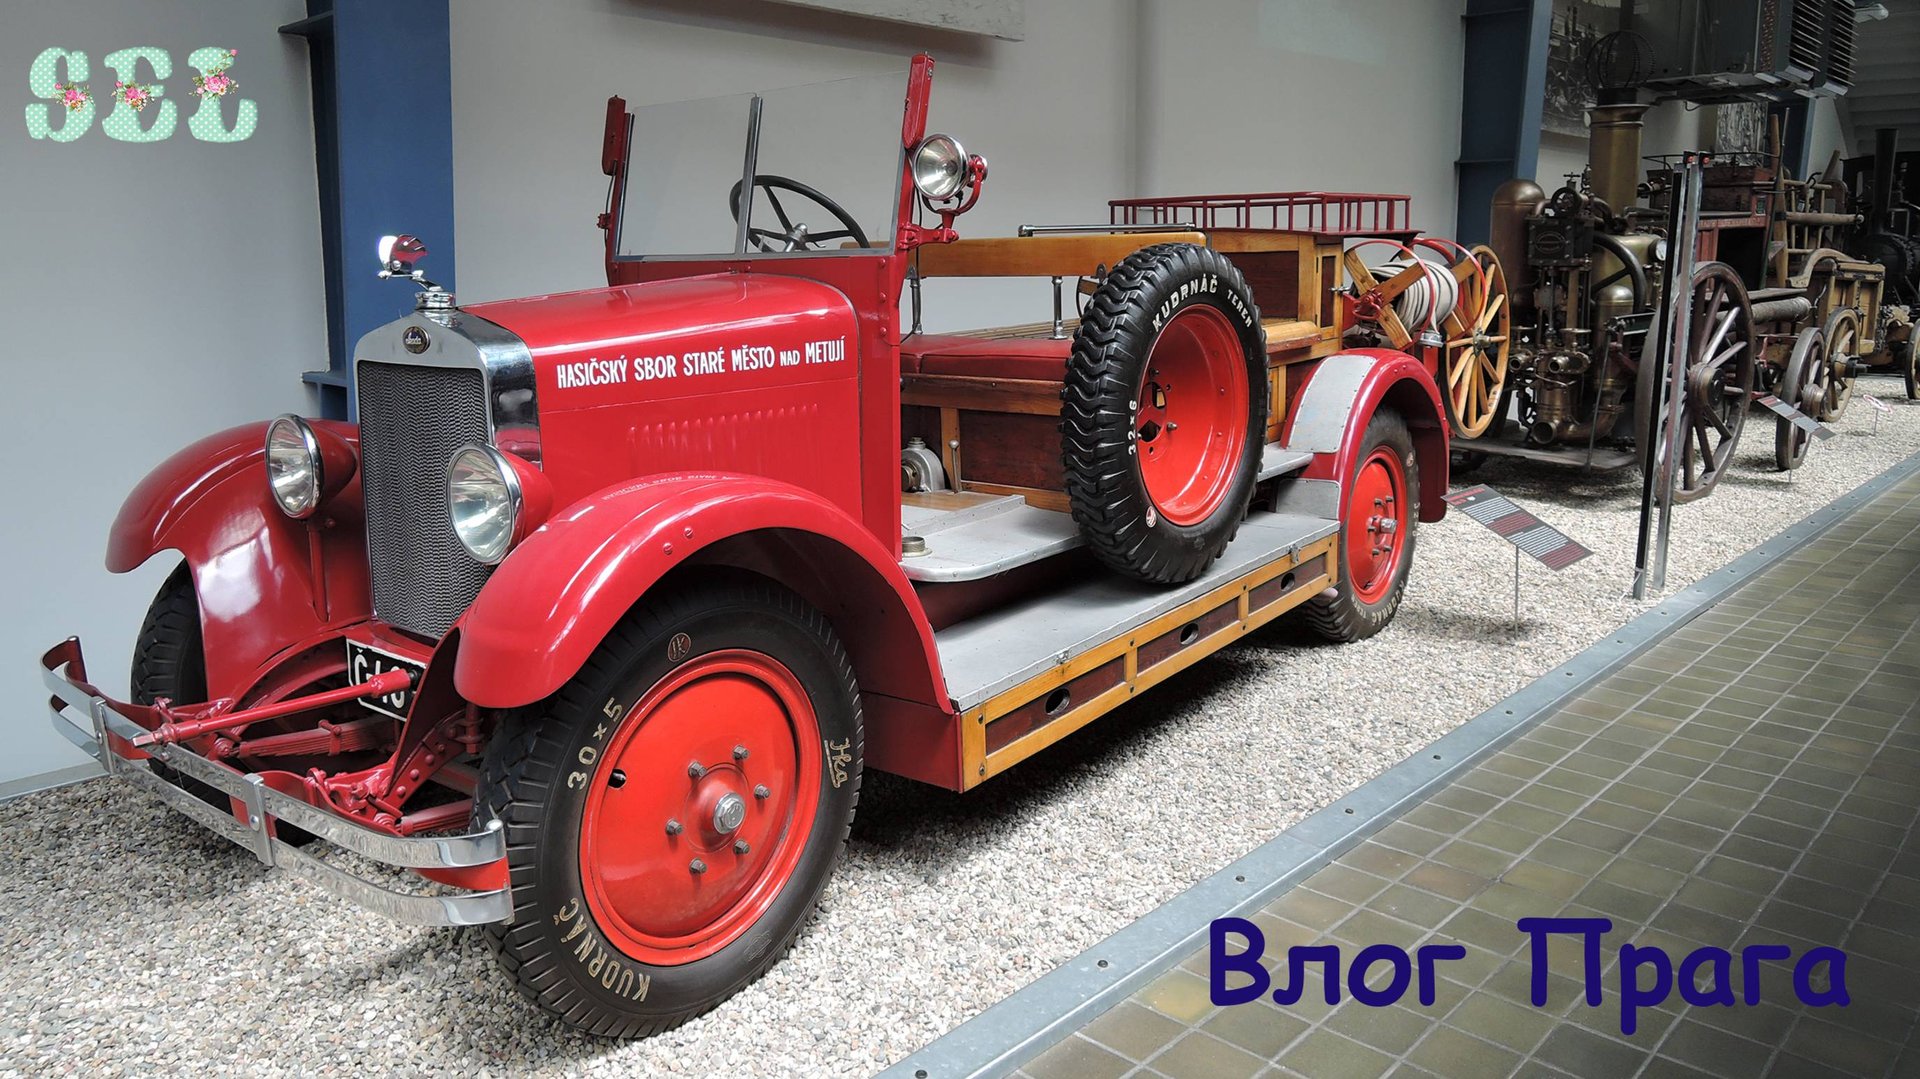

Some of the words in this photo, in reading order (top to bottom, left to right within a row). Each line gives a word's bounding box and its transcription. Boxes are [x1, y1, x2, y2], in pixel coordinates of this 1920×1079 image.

[1152, 273, 1218, 332] KUDRNÁČ
[557, 355, 627, 389] HASIČSKÝ
[634, 355, 677, 381] SBOR
[683, 347, 725, 376] STARÉ
[731, 344, 776, 372] MĚSTO
[780, 350, 801, 367] NAD
[805, 335, 846, 364] METUJÍ
[553, 898, 650, 1002] KUDRNÁČ
